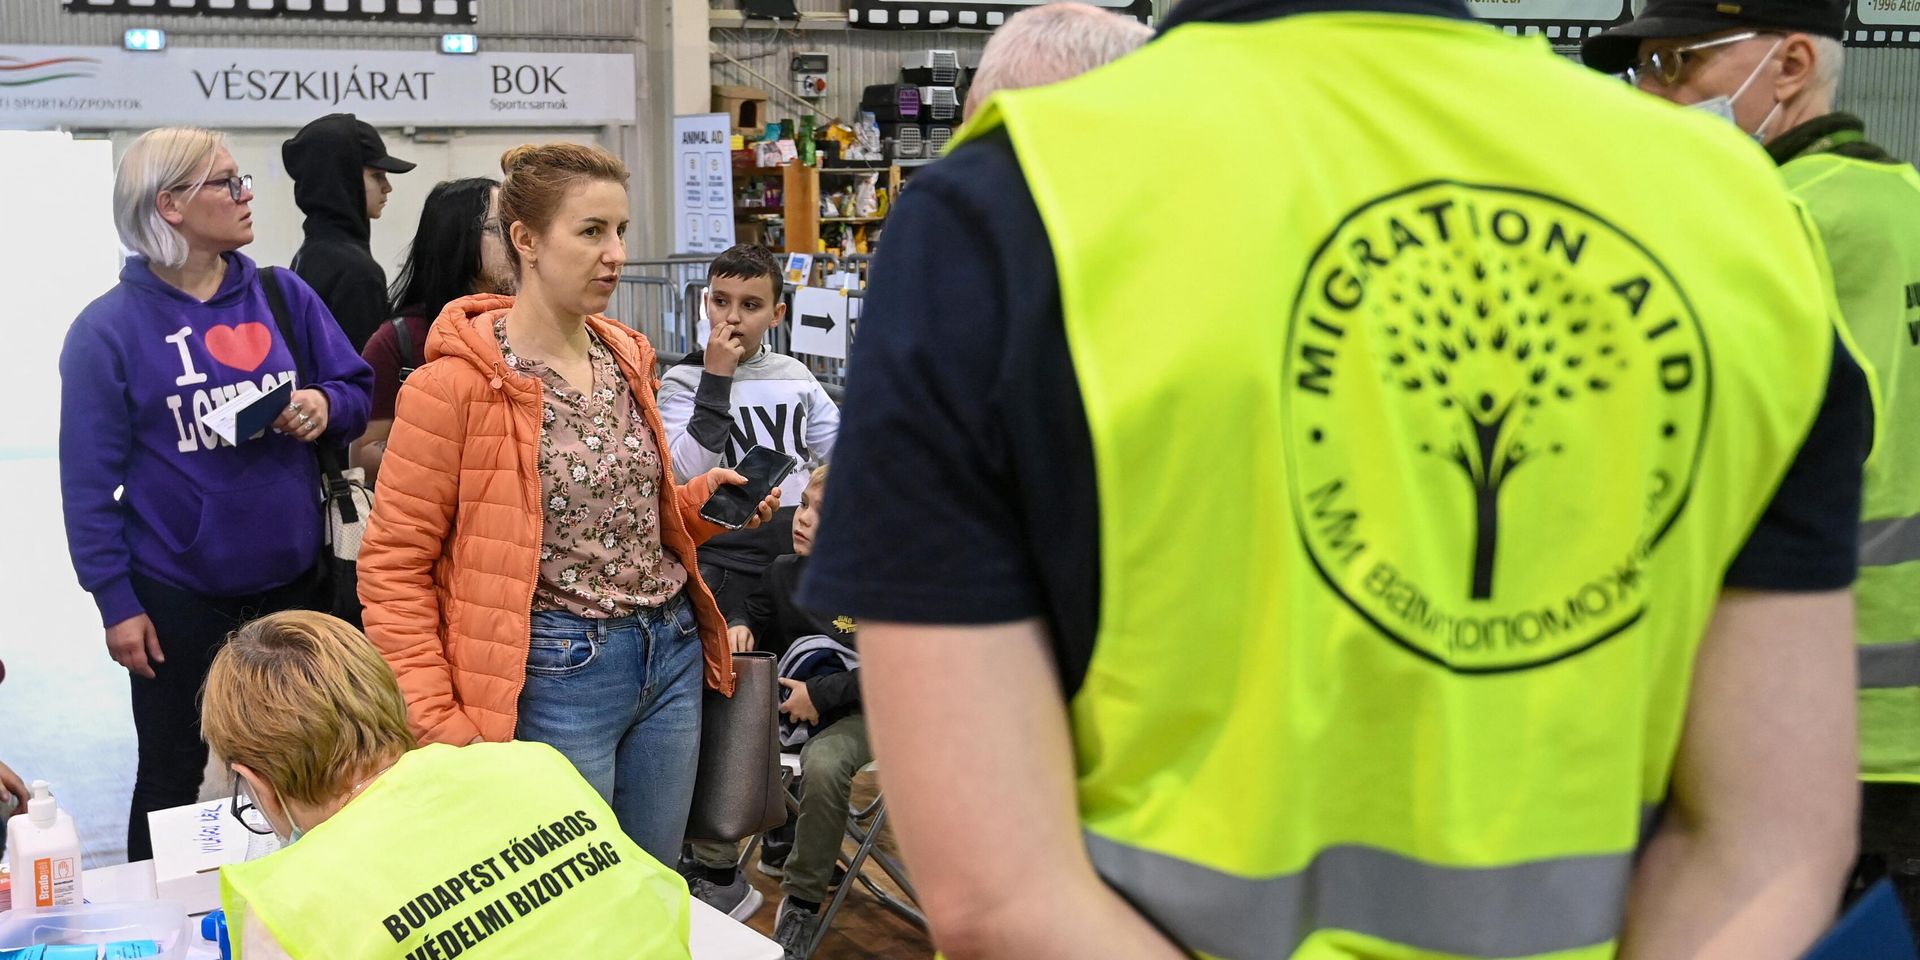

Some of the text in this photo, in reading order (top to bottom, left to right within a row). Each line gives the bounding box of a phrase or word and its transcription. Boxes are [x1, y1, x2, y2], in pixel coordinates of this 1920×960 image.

[193, 63, 435, 105] VÉSZKIJÁRAT
[490, 99, 568, 111] Sportcsarnok
[491, 65, 567, 95] BOK
[682, 131, 709, 144] ANIMAL
[1297, 202, 1694, 397] MIGRATION AID
[165, 326, 207, 386] I
[382, 810, 597, 944] BUDAPEST FŐVÁROS
[506, 841, 622, 917] BIZOTTSÁG
